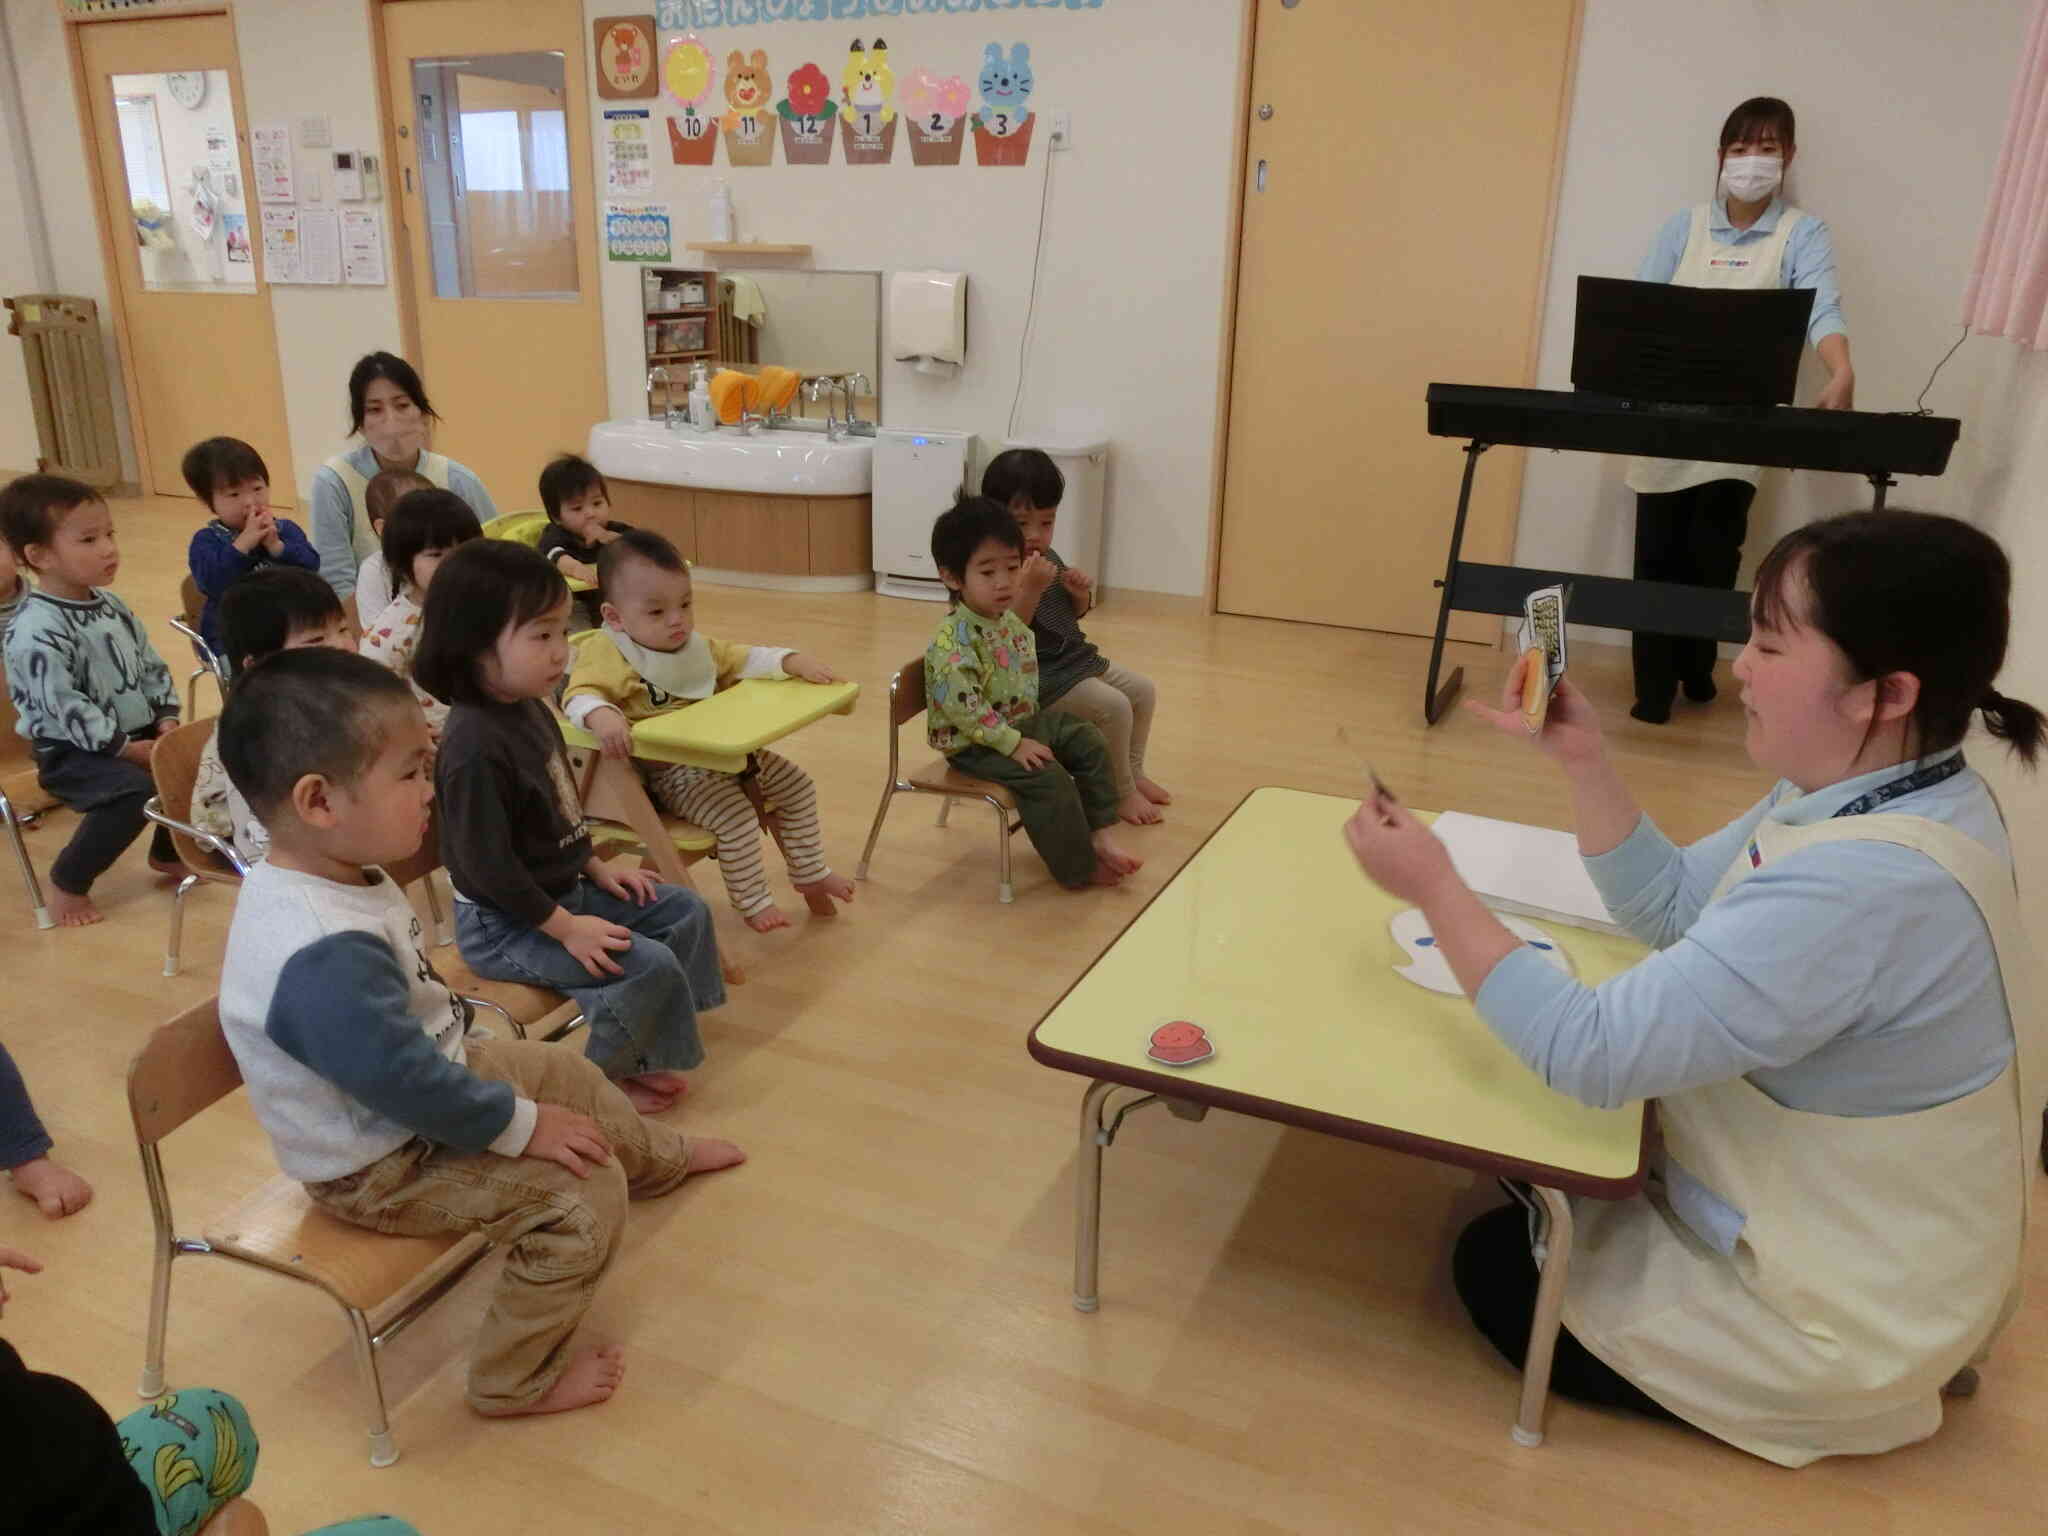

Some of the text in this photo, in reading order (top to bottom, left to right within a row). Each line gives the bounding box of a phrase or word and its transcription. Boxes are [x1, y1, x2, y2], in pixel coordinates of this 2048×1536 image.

[685, 117, 701, 137] 10
[741, 116, 756, 134] 11
[799, 115, 818, 134] 12
[863, 113, 871, 134] 1
[930, 113, 945, 131] 2
[995, 114, 1009, 135] 3
